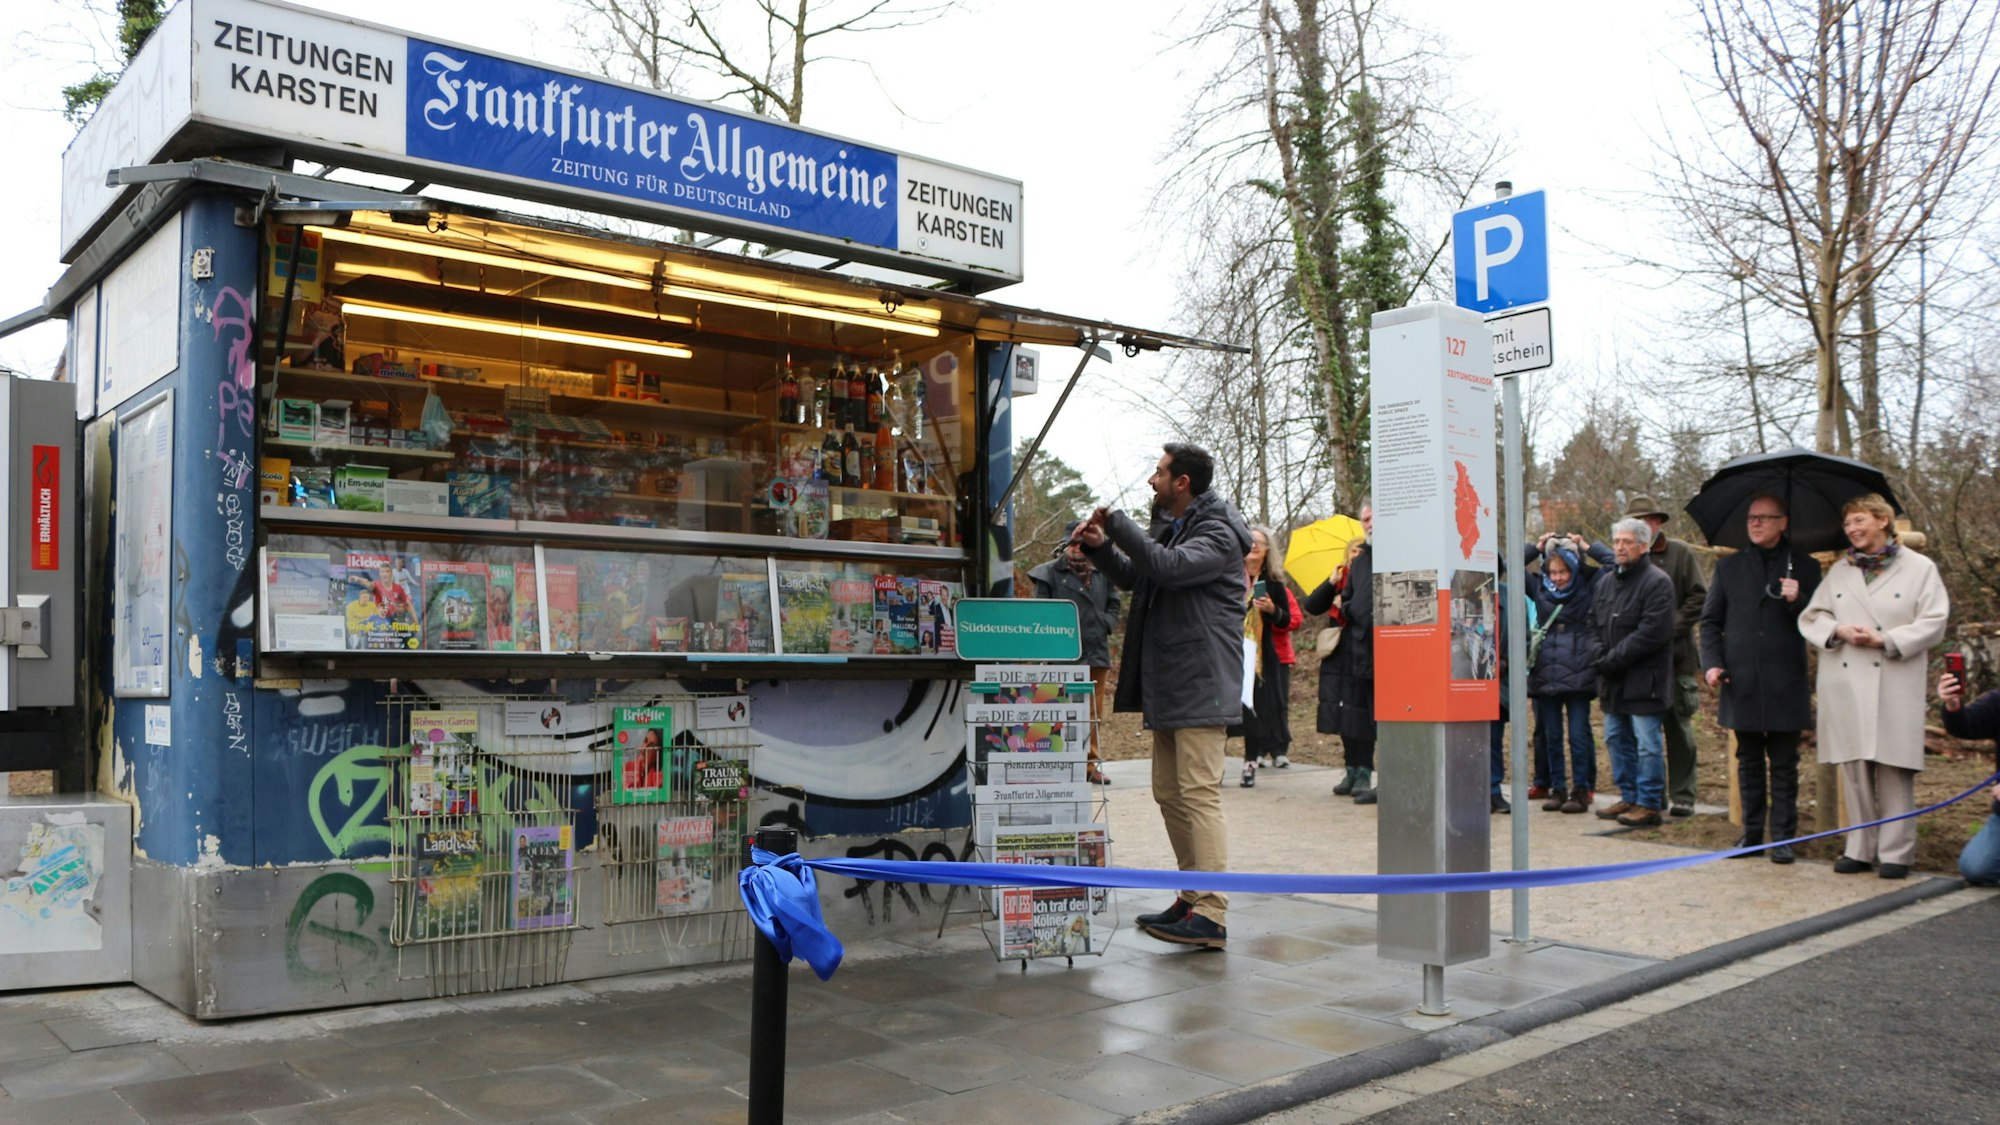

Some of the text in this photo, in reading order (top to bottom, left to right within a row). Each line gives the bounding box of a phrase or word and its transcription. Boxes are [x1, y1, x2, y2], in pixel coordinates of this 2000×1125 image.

[214, 20, 394, 85] ZEITUNGEN
[231, 62, 378, 118] KARSTEN
[422, 51, 889, 209] Frankfurter Allgemeine
[551, 157, 792, 220] ZEITUNG FÜR DEUTSCHLAND
[907, 179, 1014, 224] ZEITUNGEN
[916, 211, 1005, 250] KARSTEN
[1474, 213, 1524, 302] P
[1493, 328, 1514, 345] mit
[1446, 336, 1466, 358] 127
[379, 368, 417, 380] mentos
[1446, 368, 1493, 387] ZEITUNGSKIOSK
[261, 471, 284, 481] icola
[348, 478, 384, 489] Em-eukal
[38, 488, 51, 567] HIER ERHÄLTLICH
[874, 578, 896, 590] Gala
[960, 620, 1075, 638] Süddeutsche Zeitung
[1000, 671, 1069, 682] DIE ZEIT
[448, 718, 475, 726] Garten
[623, 708, 664, 722] Brigitte
[992, 710, 1062, 722] DIE ZEIT
[1016, 736, 1051, 749] Was nur
[702, 768, 742, 778] TRAUM-
[702, 777, 742, 788] GARTEN
[1035, 789, 1074, 800] Allgemeine
[997, 837, 1024, 845] Darum
[1025, 836, 1062, 844] brauchen
[1034, 901, 1047, 914] Ich
[1049, 898, 1068, 912] traf
[1069, 898, 1088, 912] den
[1034, 914, 1065, 927] Kölner
[1034, 927, 1057, 941] Wolf
